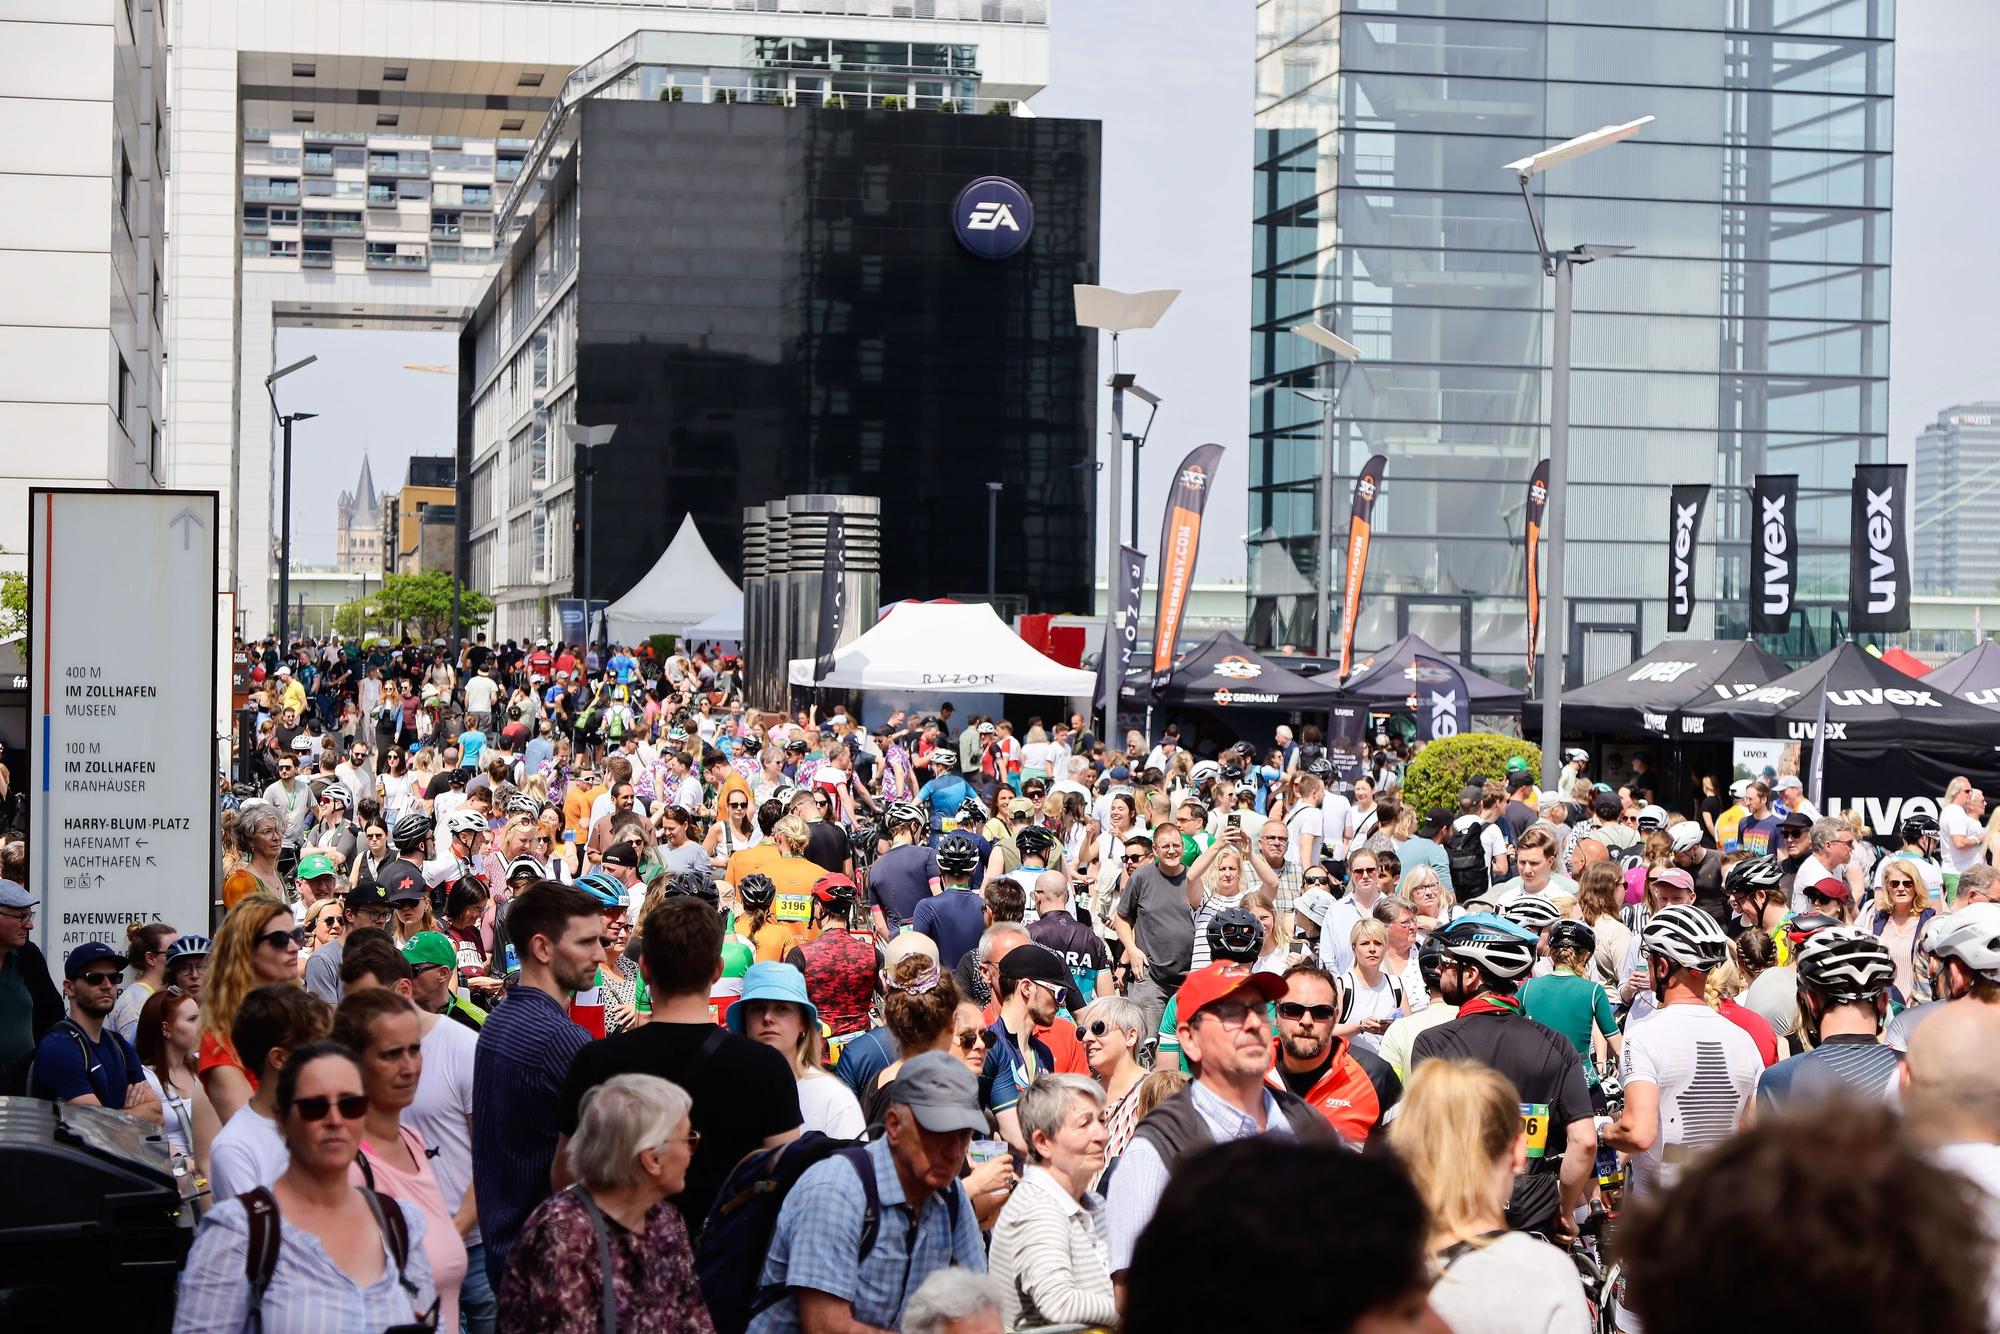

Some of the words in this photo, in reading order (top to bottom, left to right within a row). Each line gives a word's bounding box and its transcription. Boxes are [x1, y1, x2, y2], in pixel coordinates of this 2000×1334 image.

[967, 202, 1020, 231] EA
[1762, 494, 1790, 615] uvex
[1866, 486, 1896, 614] uvex
[1675, 502, 1697, 615] uvex
[1122, 564, 1141, 663] RYZON
[65, 666, 86, 678] 400
[90, 666, 101, 678] M
[923, 673, 994, 684] RYZON
[65, 685, 82, 697] IM
[85, 685, 157, 697] ZOLLHAFEN
[1233, 693, 1279, 703] GERMANY
[1826, 688, 1942, 707] uvex
[1964, 688, 2000, 705] u
[65, 704, 116, 716] MUSEEN
[1431, 689, 1457, 741] ex
[1682, 717, 1705, 733] uvex
[1788, 722, 1847, 740] uvex
[65, 742, 85, 754] 100
[89, 742, 101, 754] M
[1743, 750, 1768, 758] uvex
[64, 761, 81, 773] IM
[85, 761, 156, 773] ZOLLHAFEN
[64, 778, 146, 792] KRANHÄUSER
[1827, 796, 1946, 836] uve
[64, 837, 131, 849] HAFENAMT
[63, 856, 141, 868] YACHTHAFEN
[781, 901, 806, 911] 3196
